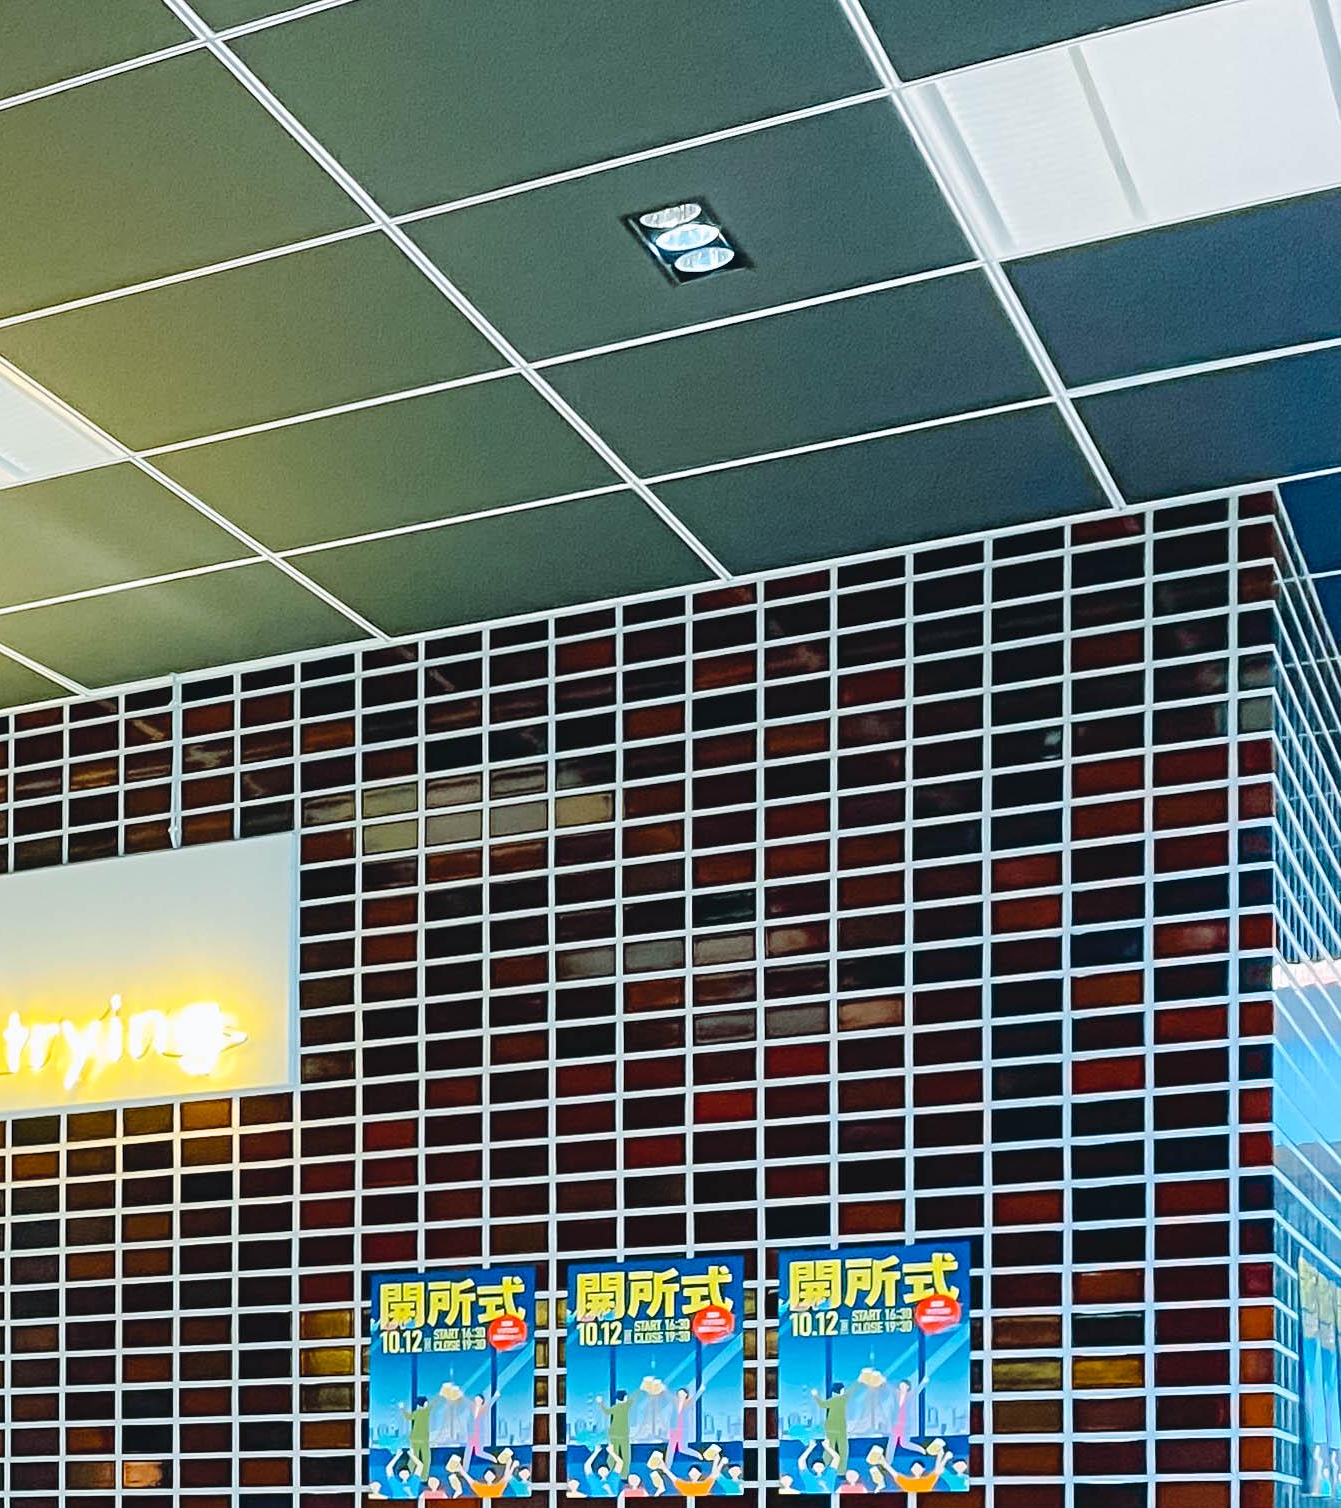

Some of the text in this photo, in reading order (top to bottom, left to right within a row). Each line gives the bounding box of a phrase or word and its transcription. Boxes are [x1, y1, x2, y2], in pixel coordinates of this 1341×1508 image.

[3, 993, 229, 1090] trying
[576, 1265, 734, 1322] 開所式
[789, 1252, 960, 1312] 開所式
[380, 1276, 527, 1331] 開所式
[852, 1309, 881, 1322] START
[433, 1328, 459, 1340] START
[576, 1321, 622, 1346] 10.12
[634, 1320, 661, 1332] START
[789, 1311, 838, 1336] 10.12
[851, 1322, 883, 1334] CLOSE
[380, 1330, 423, 1354] 10.12
[433, 1339, 461, 1351] CLOSE
[634, 1332, 663, 1344] CLOSE
